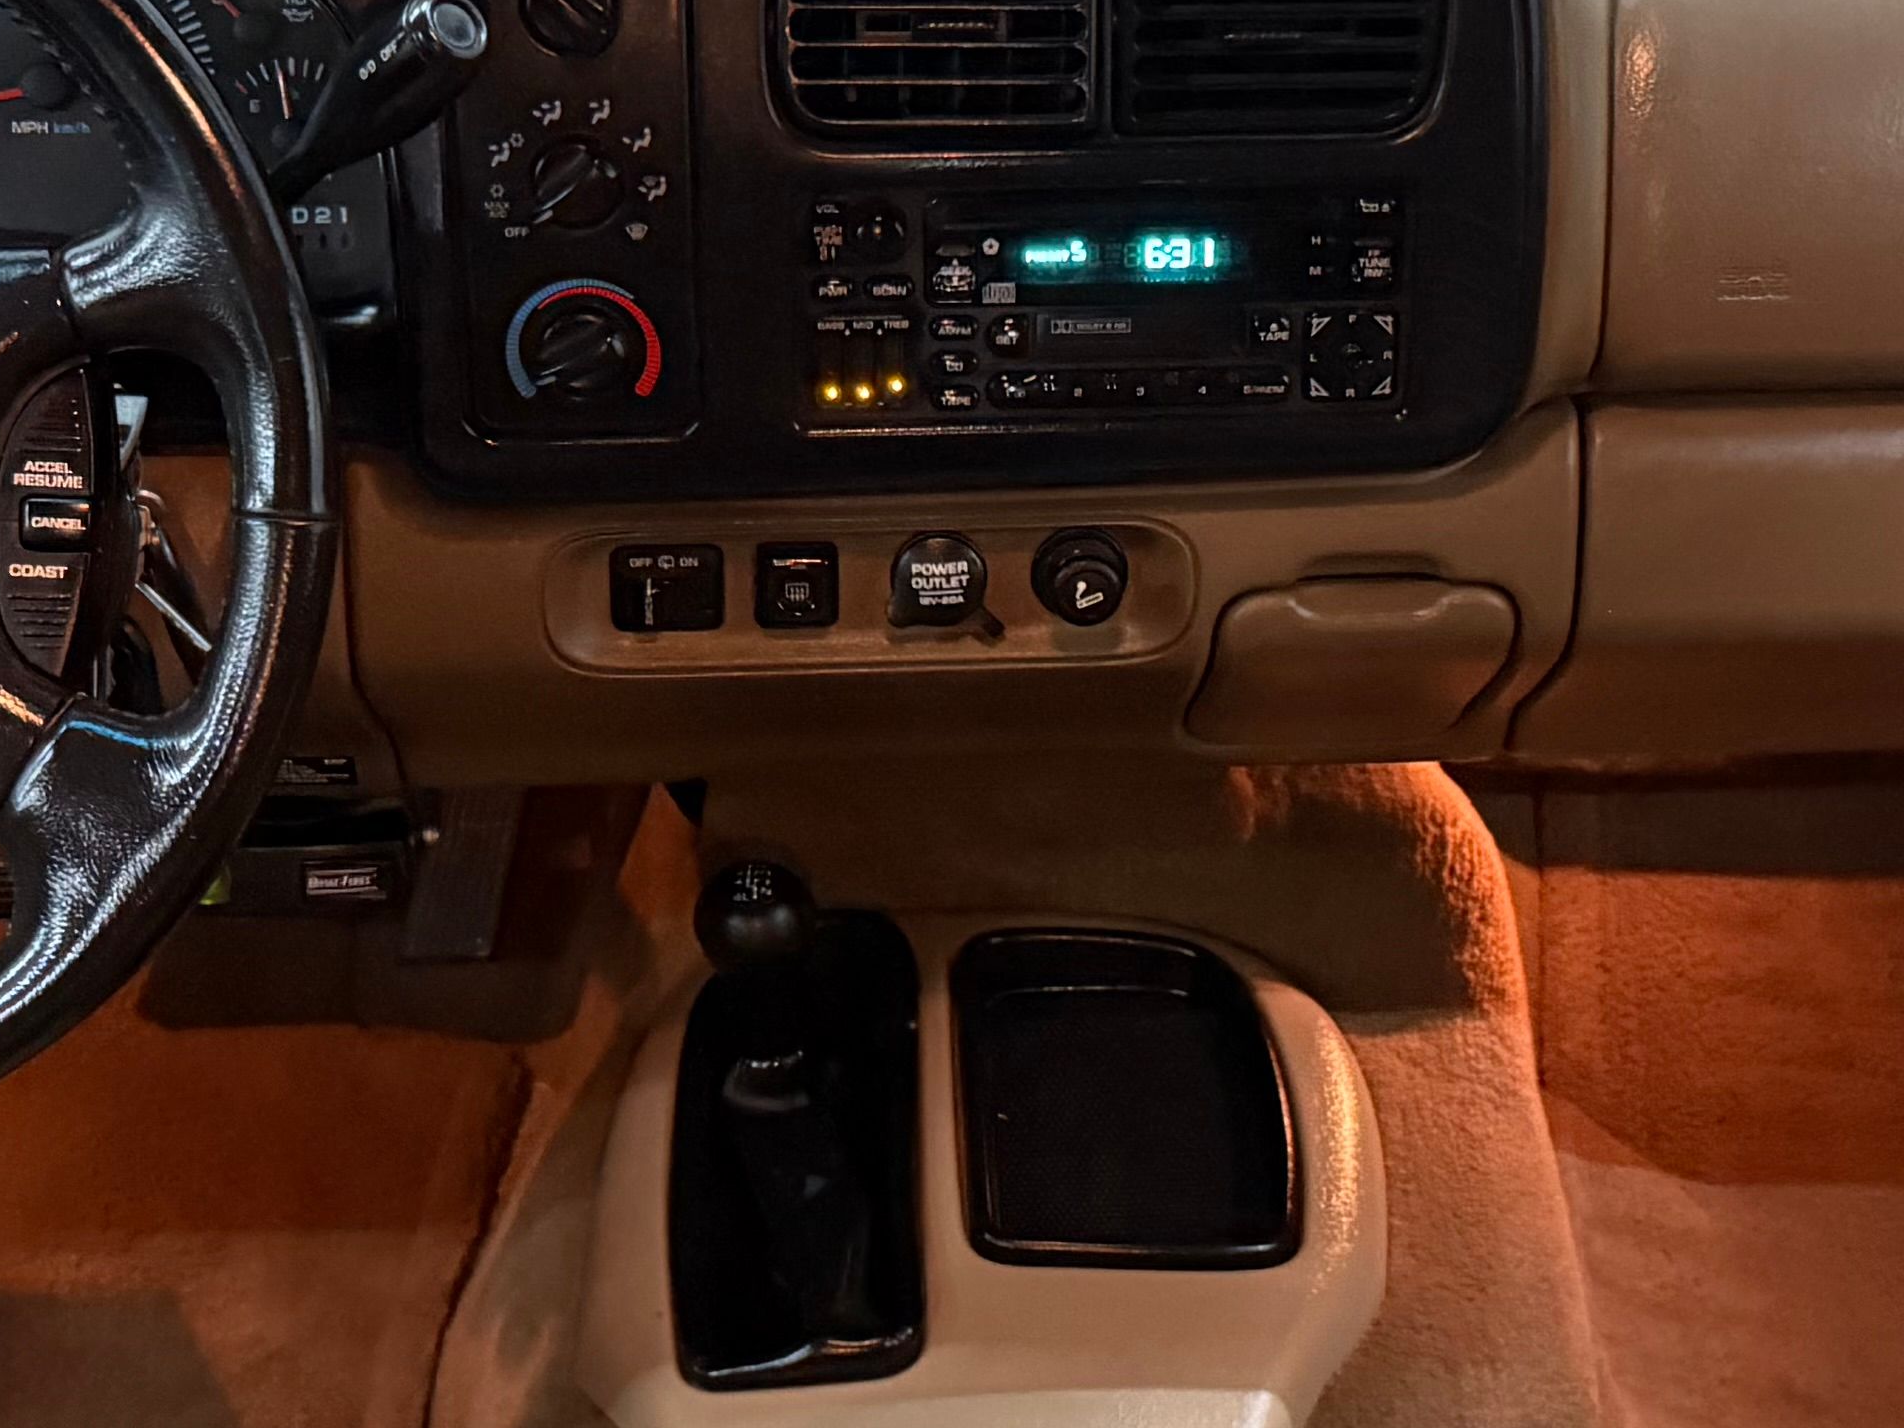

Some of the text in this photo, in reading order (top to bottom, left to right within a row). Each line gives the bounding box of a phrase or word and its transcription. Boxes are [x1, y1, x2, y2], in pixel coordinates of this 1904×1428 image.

[11, 120, 49, 135] MPH
[313, 205, 333, 225] 2
[338, 205, 349, 225] 1
[815, 203, 840, 214] VOL
[504, 226, 530, 238] OFF
[1358, 257, 1391, 269] TUNE
[1258, 330, 1291, 342] TAPE
[23, 459, 75, 475] ACCEL
[11, 471, 85, 490] RESUME
[30, 515, 87, 533] CANCEL
[629, 556, 700, 568] OFF ON
[911, 560, 969, 576] POWER
[7, 562, 69, 581] COAST
[911, 574, 971, 590] OUTLET
